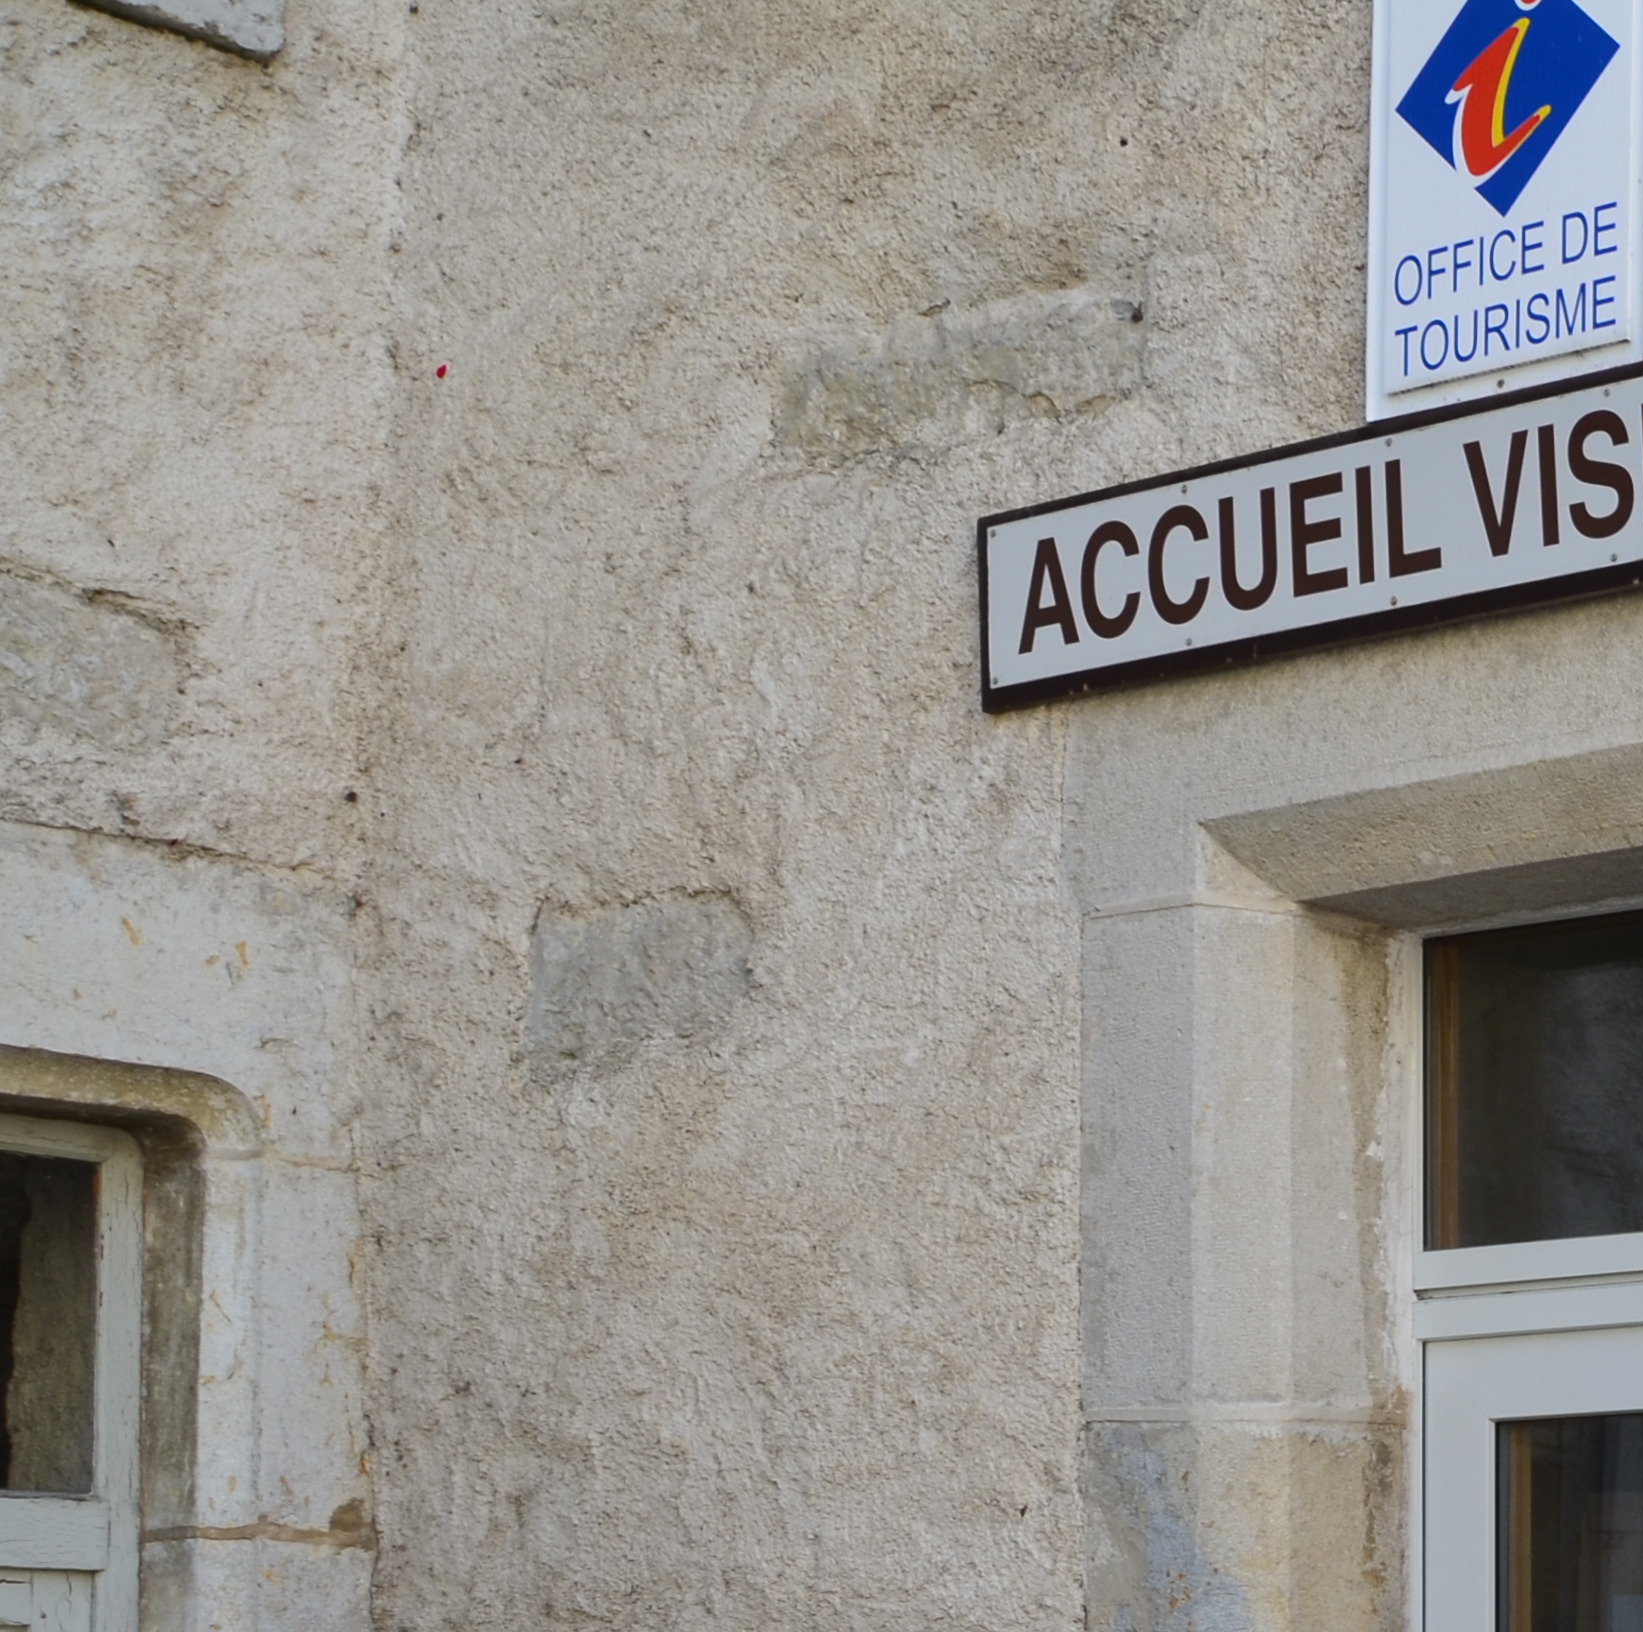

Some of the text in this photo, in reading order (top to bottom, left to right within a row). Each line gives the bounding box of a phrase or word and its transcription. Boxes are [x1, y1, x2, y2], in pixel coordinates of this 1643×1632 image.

[1395, 202, 1618, 305] OFFICE DE
[1395, 275, 1616, 377] TOURISME
[1018, 457, 1441, 654] ACCUEIL
